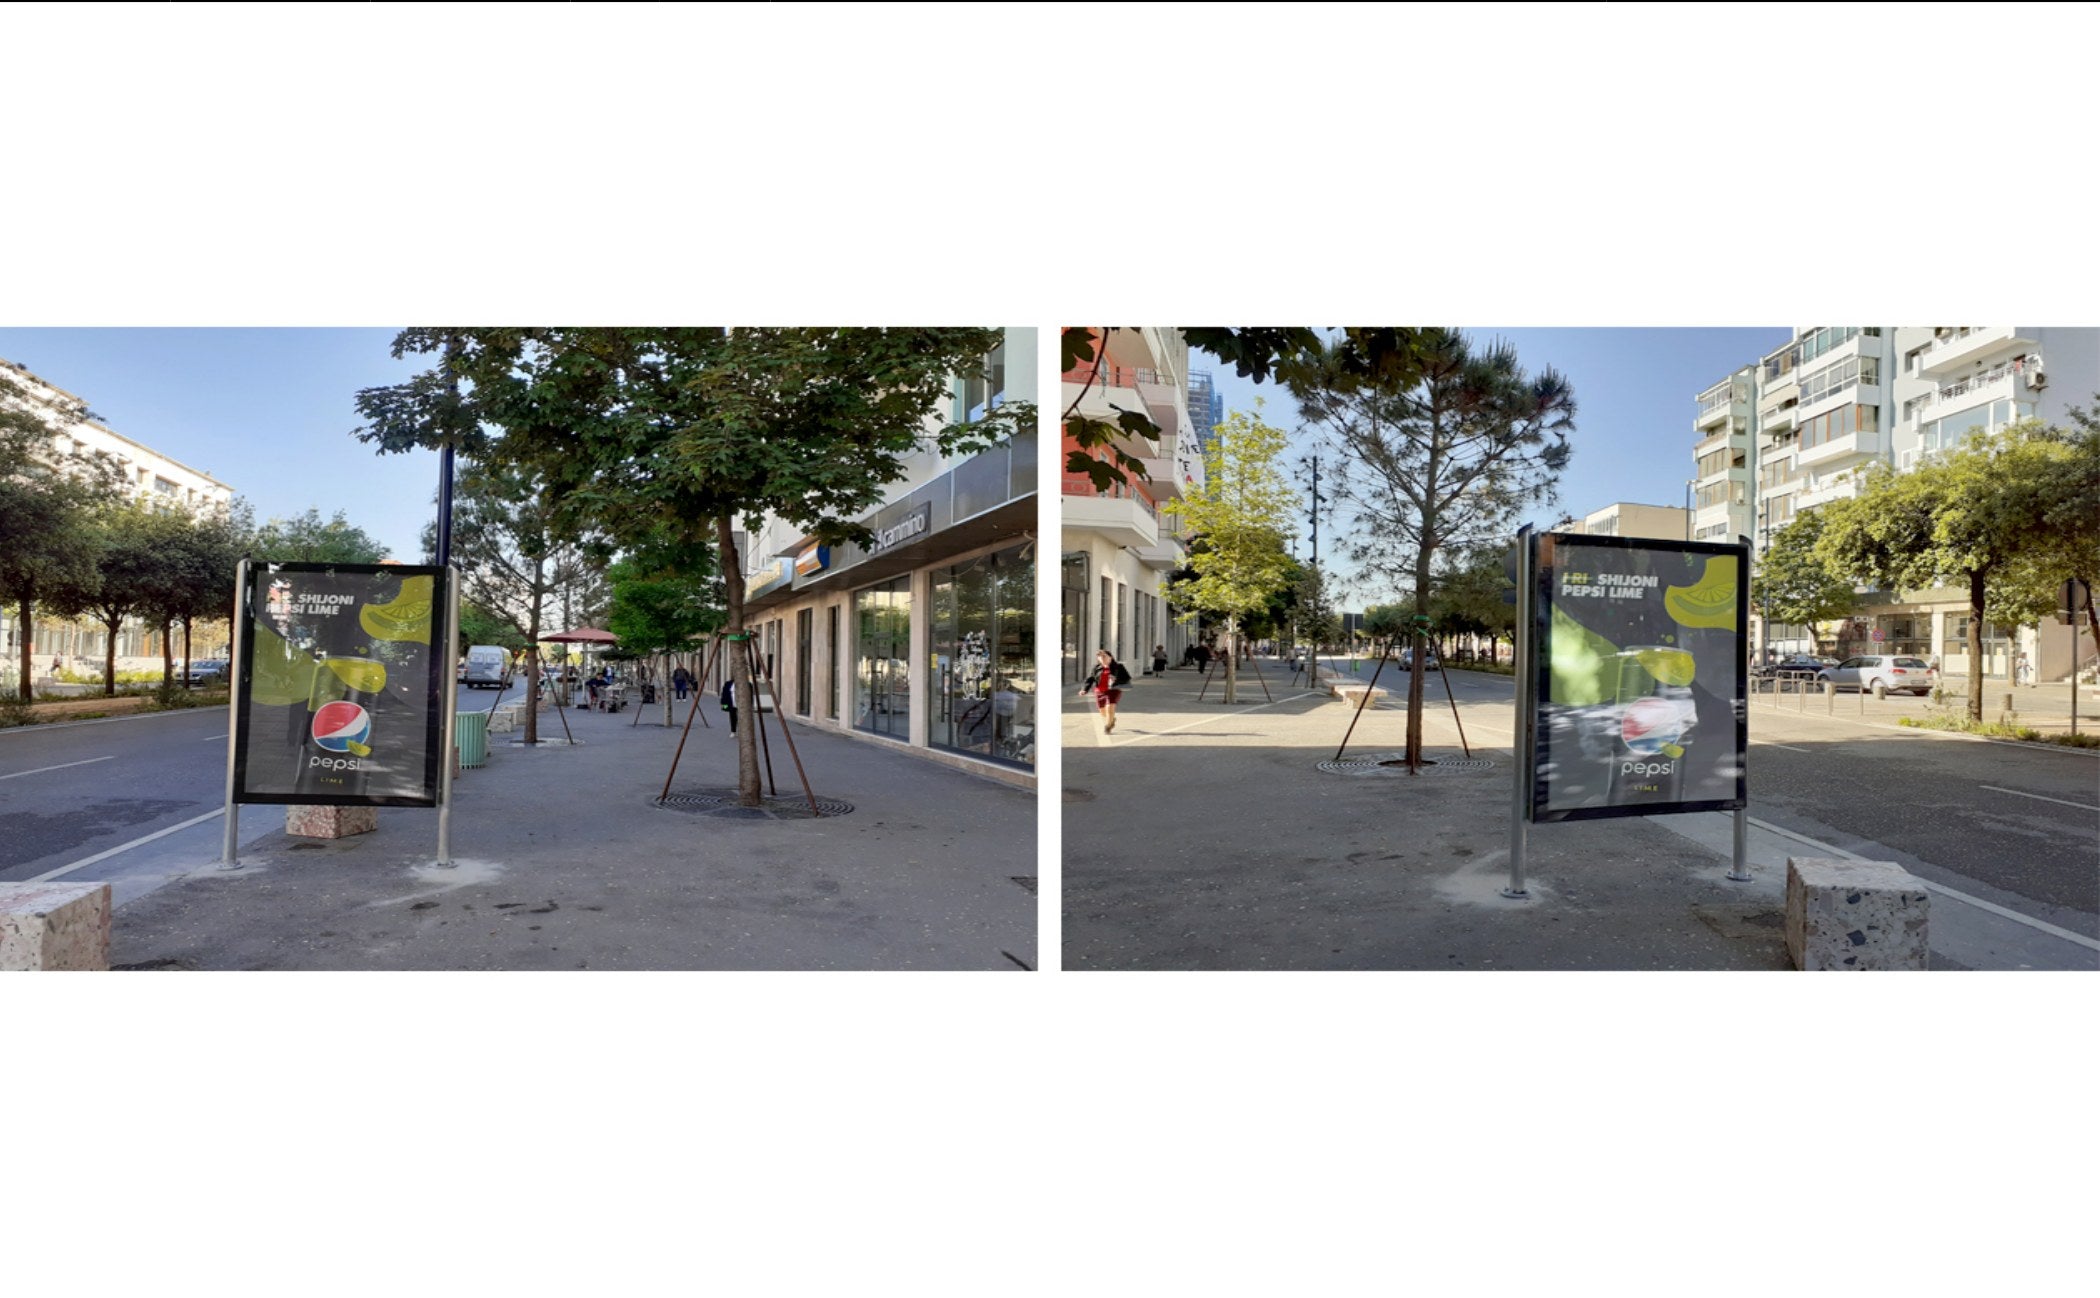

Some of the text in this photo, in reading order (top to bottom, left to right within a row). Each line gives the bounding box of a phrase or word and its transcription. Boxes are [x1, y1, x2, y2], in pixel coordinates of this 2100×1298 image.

[1597, 573, 1659, 588] SHIJONI
[1561, 584, 1645, 599] PEPSI LIME
[298, 594, 355, 605] SHIJONI
[307, 604, 340, 615] LIME
[308, 756, 361, 772] pepsi
[1621, 760, 1675, 778] pepsi
